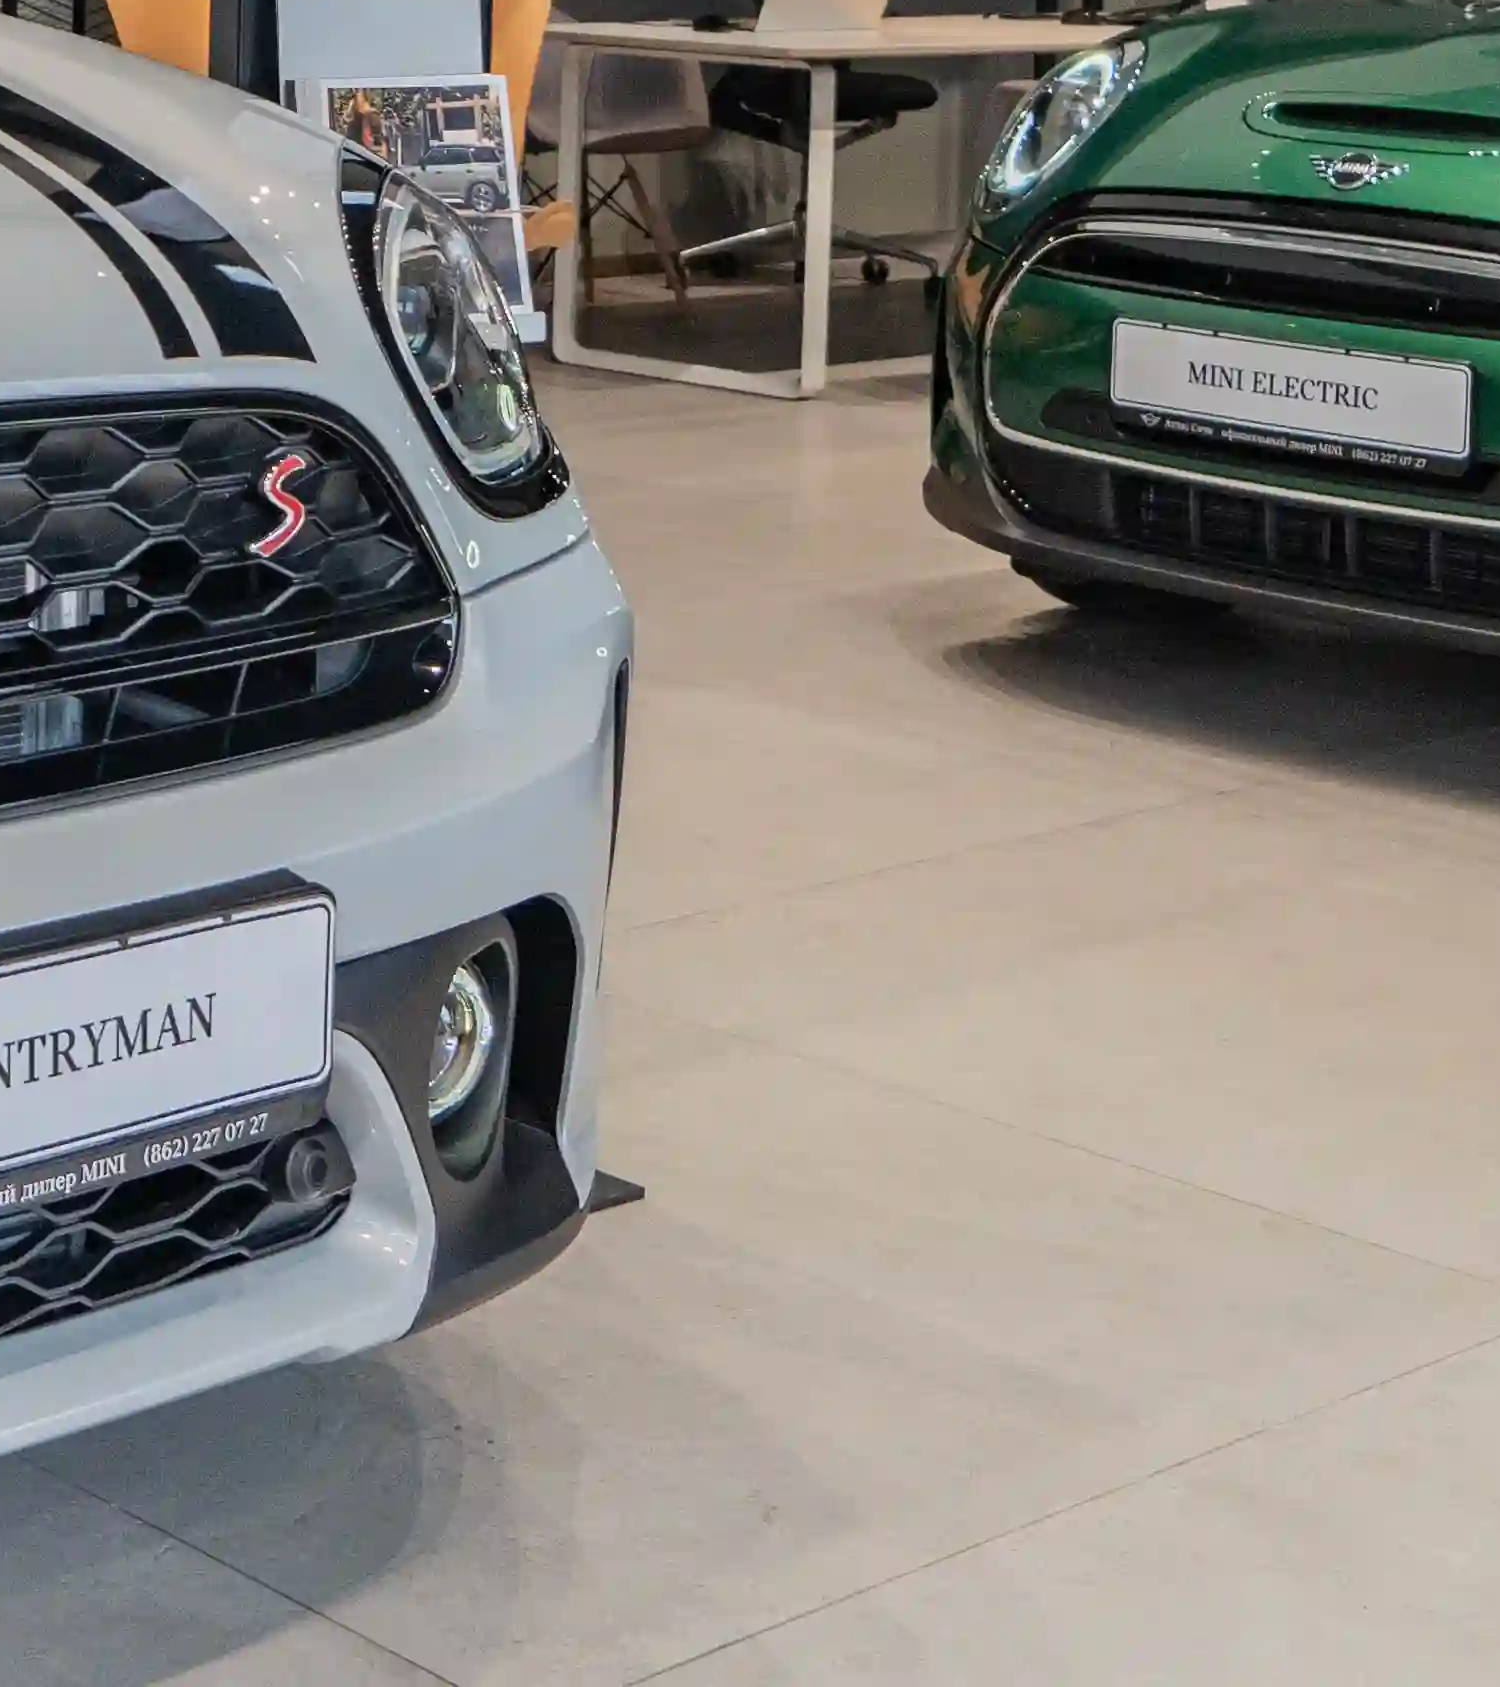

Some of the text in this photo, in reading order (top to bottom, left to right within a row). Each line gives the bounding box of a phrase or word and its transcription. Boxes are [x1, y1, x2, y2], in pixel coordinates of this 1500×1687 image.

[1187, 361, 1379, 410] MINI ELECTRIC
[249, 454, 306, 558] S
[20, 1172, 77, 1203] дилер
[80, 1152, 127, 1184] MINI
[143, 1137, 189, 1168] (862)
[192, 1127, 221, 1152] 227
[224, 1120, 244, 1142] 07
[249, 1113, 269, 1133] 27
